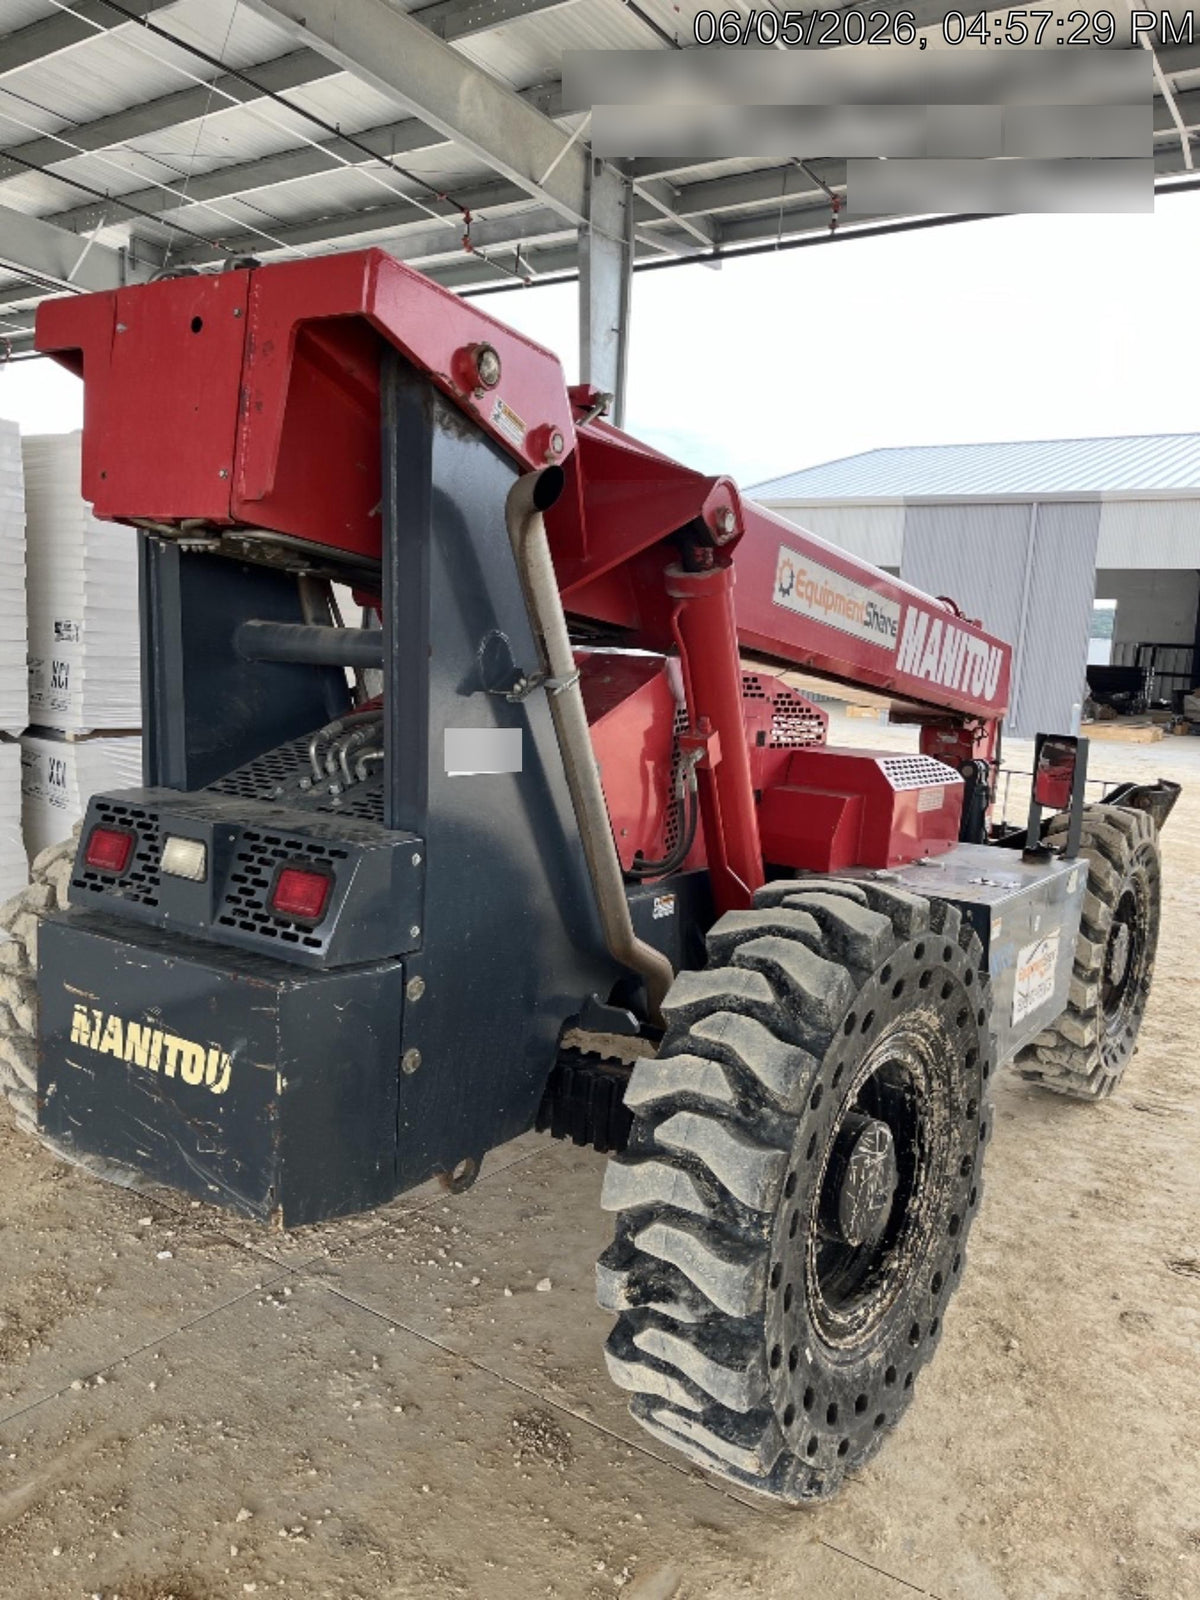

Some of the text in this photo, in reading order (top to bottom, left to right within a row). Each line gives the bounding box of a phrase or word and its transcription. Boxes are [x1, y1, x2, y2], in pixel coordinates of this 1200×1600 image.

[795, 568, 898, 638] EquipmentShare
[896, 604, 1004, 701] MANITOU
[70, 1003, 232, 1095] MANITOU
